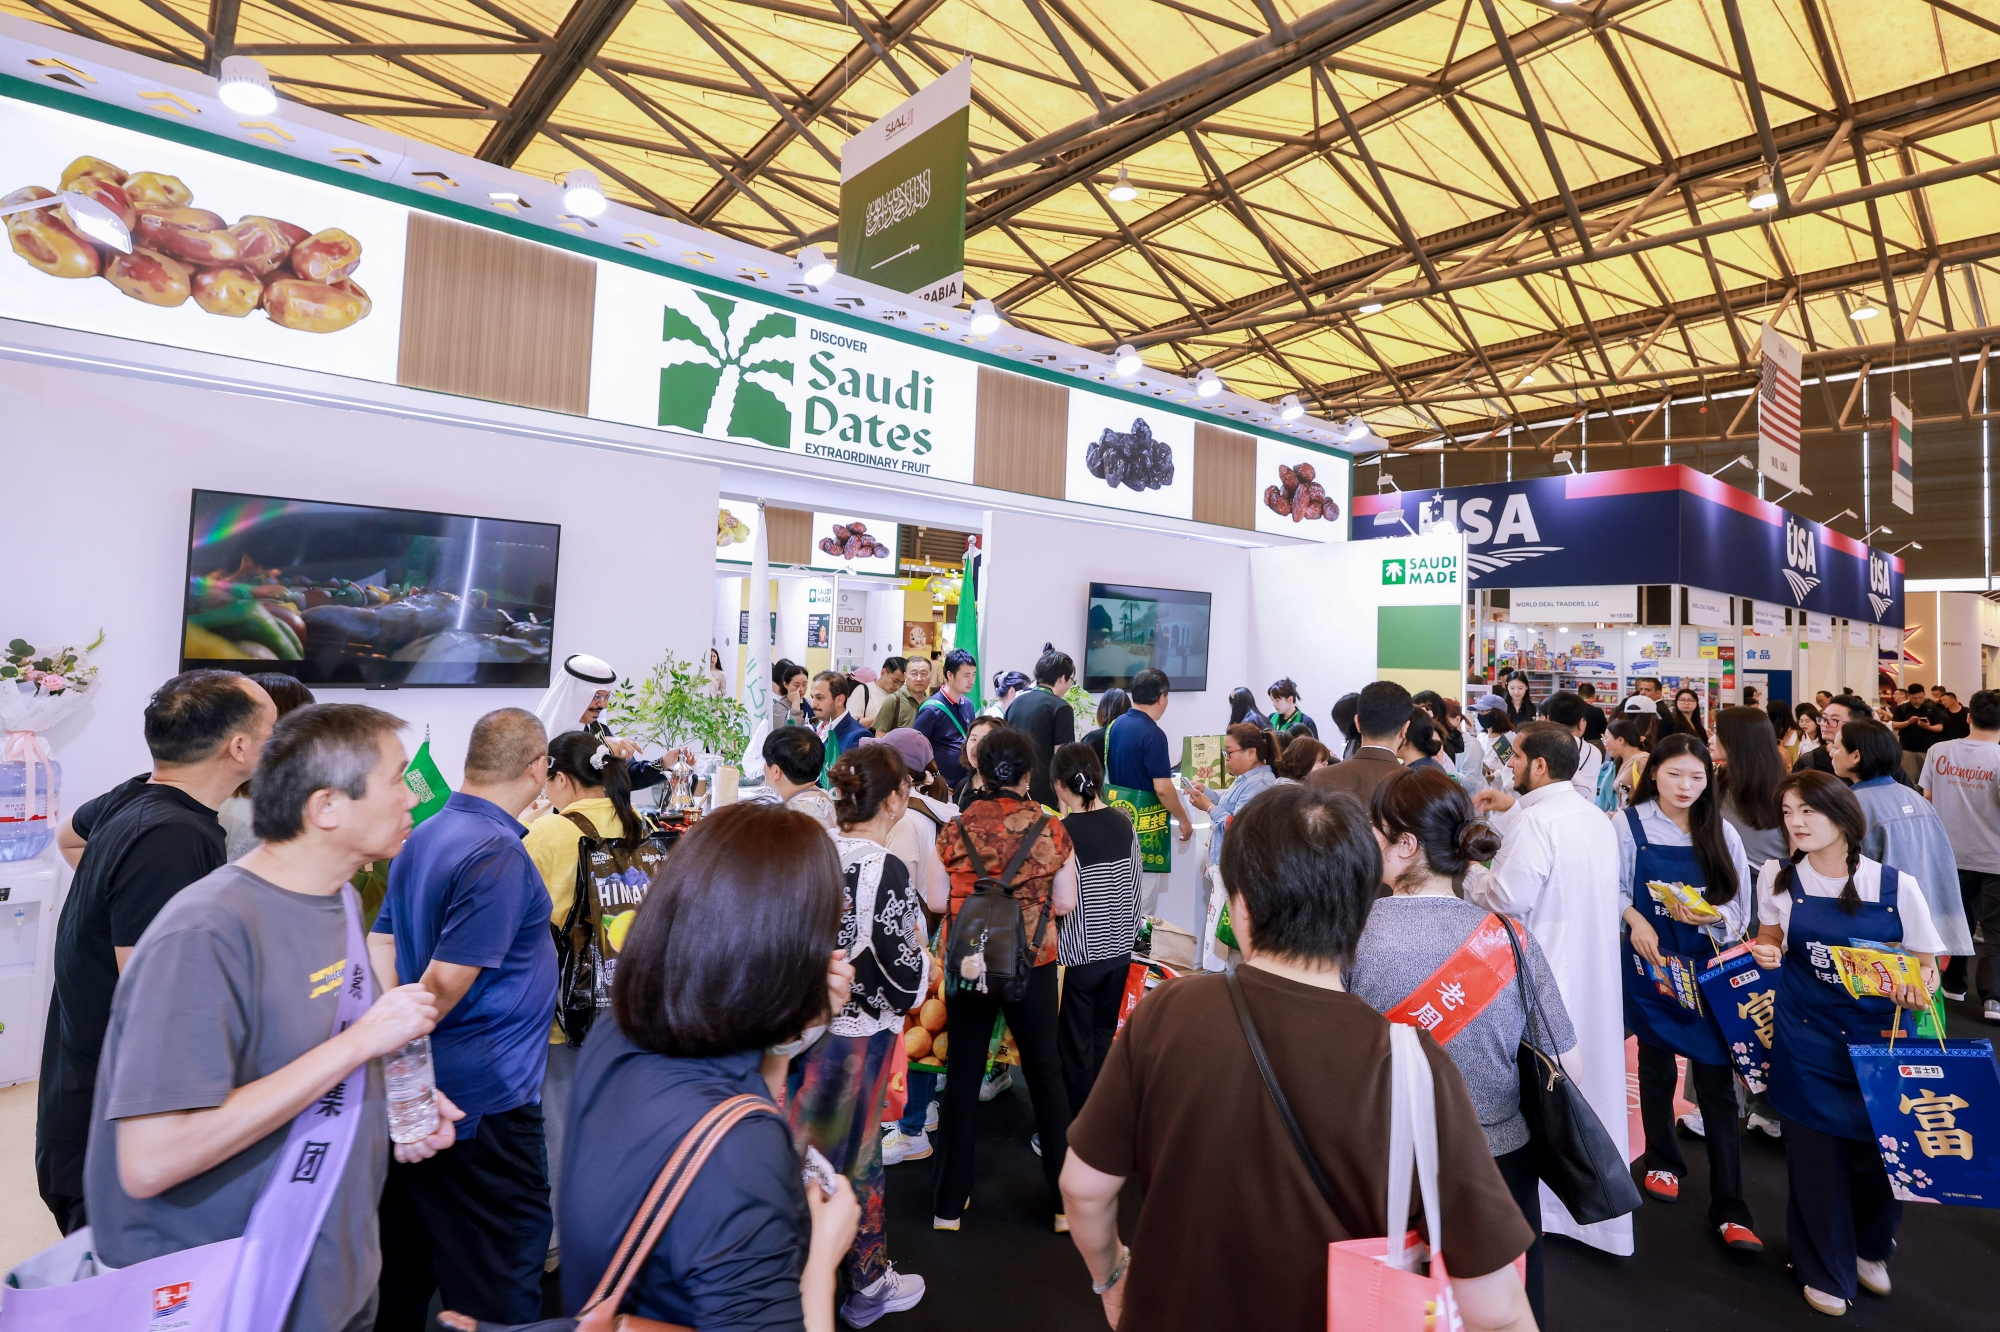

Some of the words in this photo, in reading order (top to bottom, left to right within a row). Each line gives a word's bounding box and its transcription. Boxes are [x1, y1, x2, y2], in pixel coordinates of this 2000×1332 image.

[918, 281, 957, 302] RABIA
[810, 328, 868, 353] DISCOVER
[808, 350, 935, 414] Saudi
[804, 395, 933, 456] Dates
[805, 442, 899, 469] EXTRAORDINARY
[901, 460, 931, 475] FRUIT
[1419, 493, 1541, 545] USA
[1409, 556, 1457, 570] SAUDI
[1786, 518, 1817, 575] USA
[1409, 571, 1457, 585] MADE
[1870, 553, 1891, 597] USA
[1746, 649, 1770, 660] 食品
[1935, 755, 1995, 782] Champion
[1736, 988, 1776, 1050] 富
[1913, 1066, 1940, 1075] 富士町
[1898, 1088, 1974, 1161] 富
